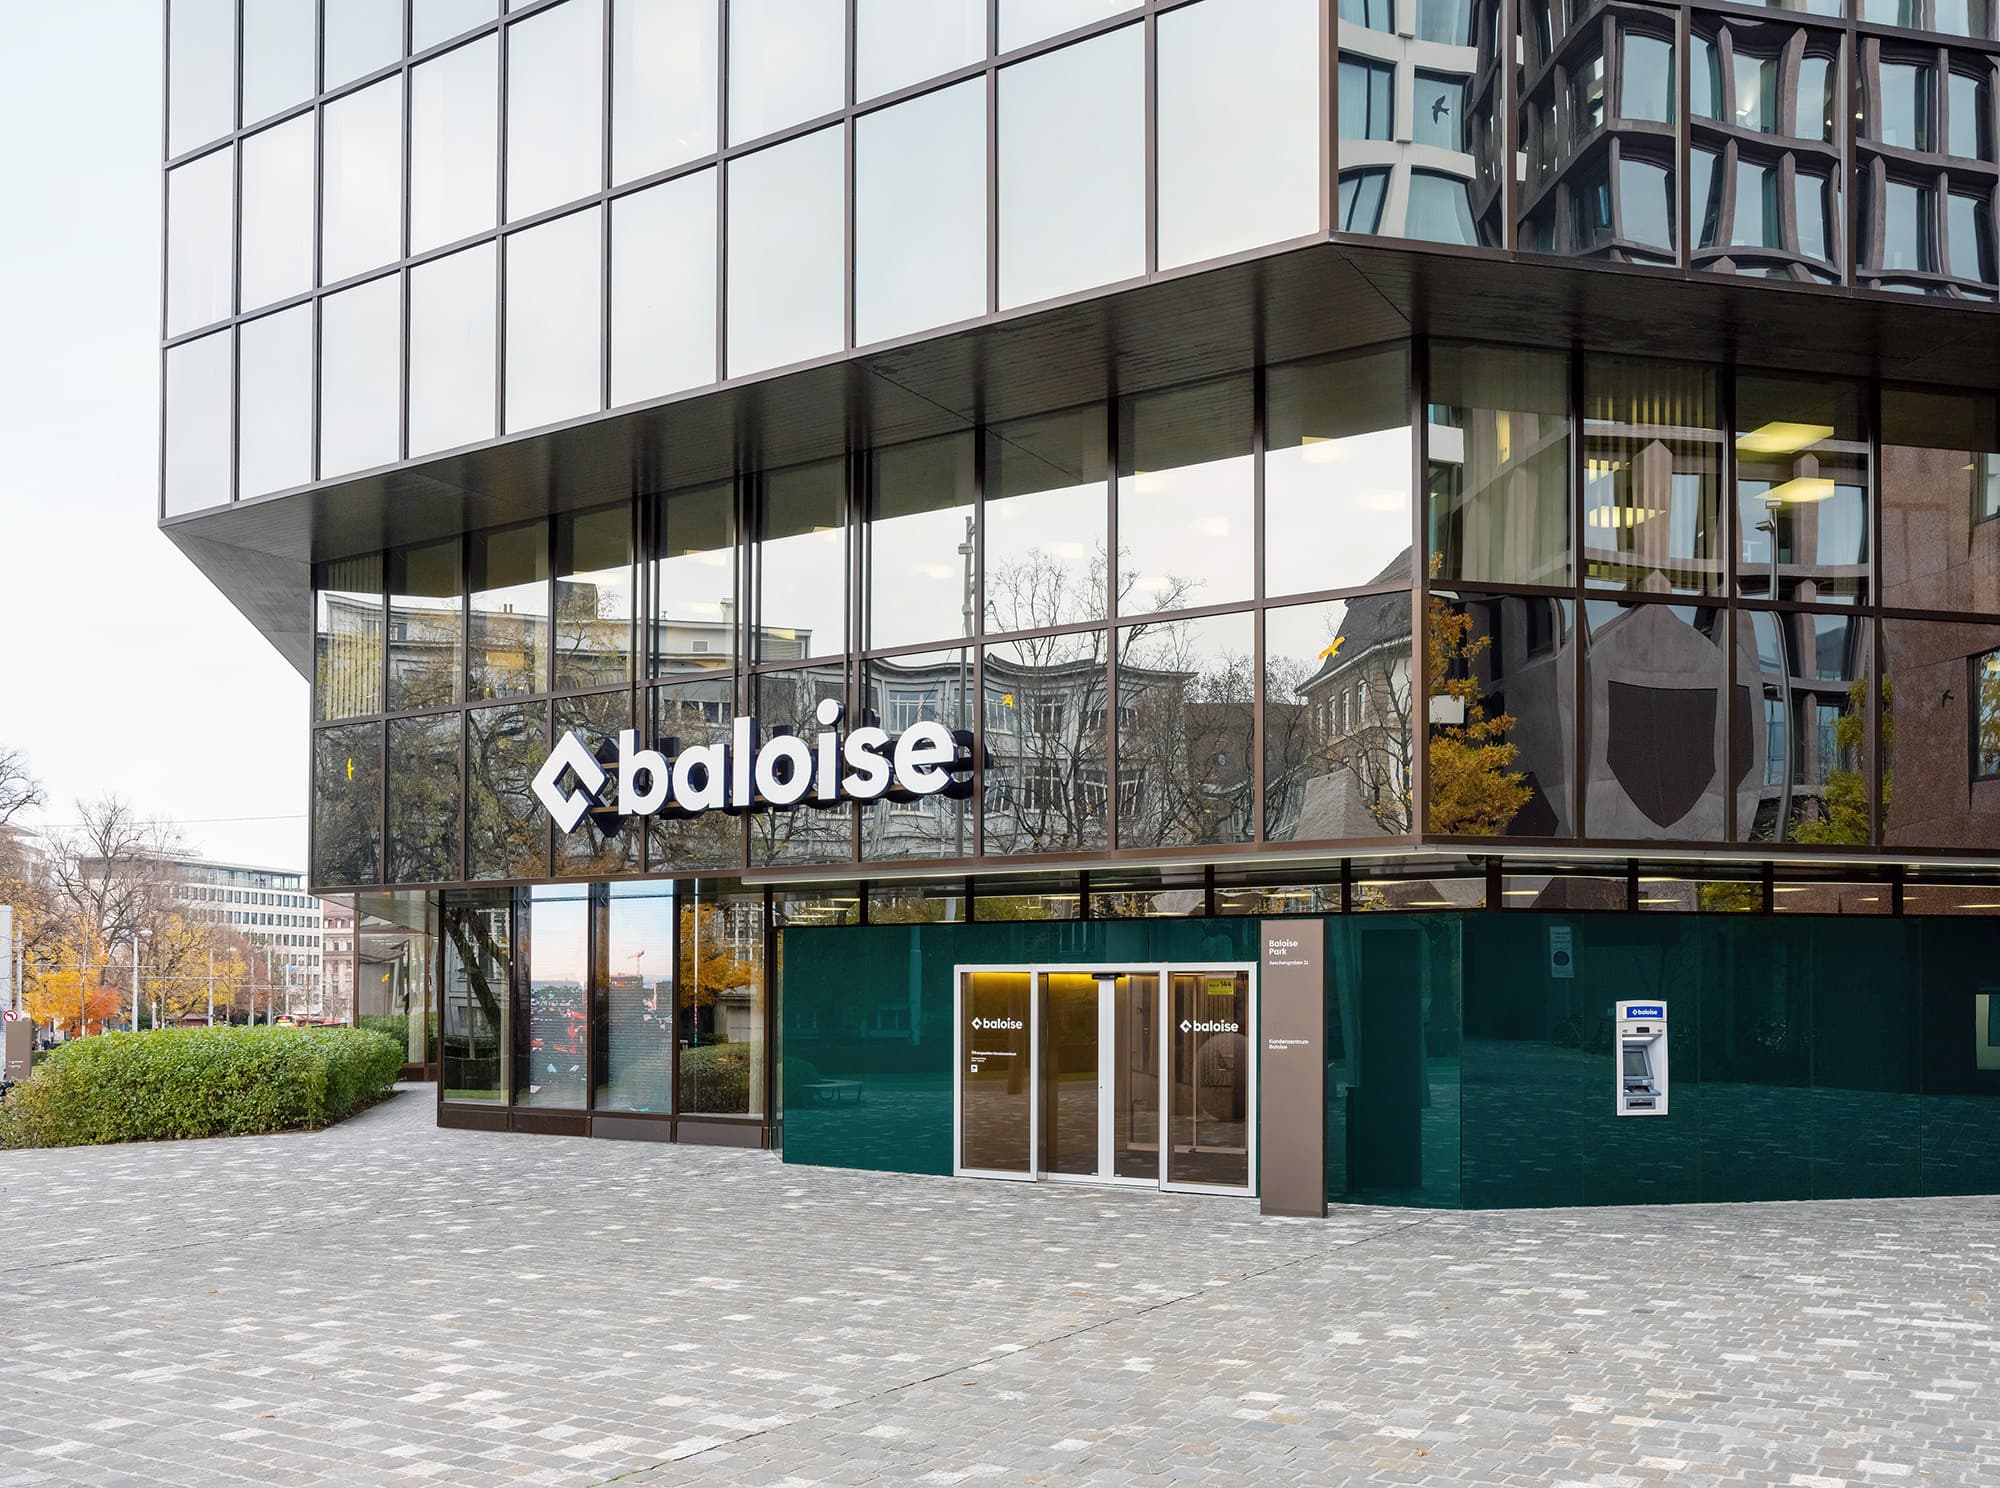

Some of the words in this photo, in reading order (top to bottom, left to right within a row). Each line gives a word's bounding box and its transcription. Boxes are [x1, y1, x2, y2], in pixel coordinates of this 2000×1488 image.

[618, 698, 956, 816] baloise
[1269, 939, 1298, 947] Baloise
[983, 1017, 1023, 1029] baloise
[1193, 1019, 1239, 1032] baloise
